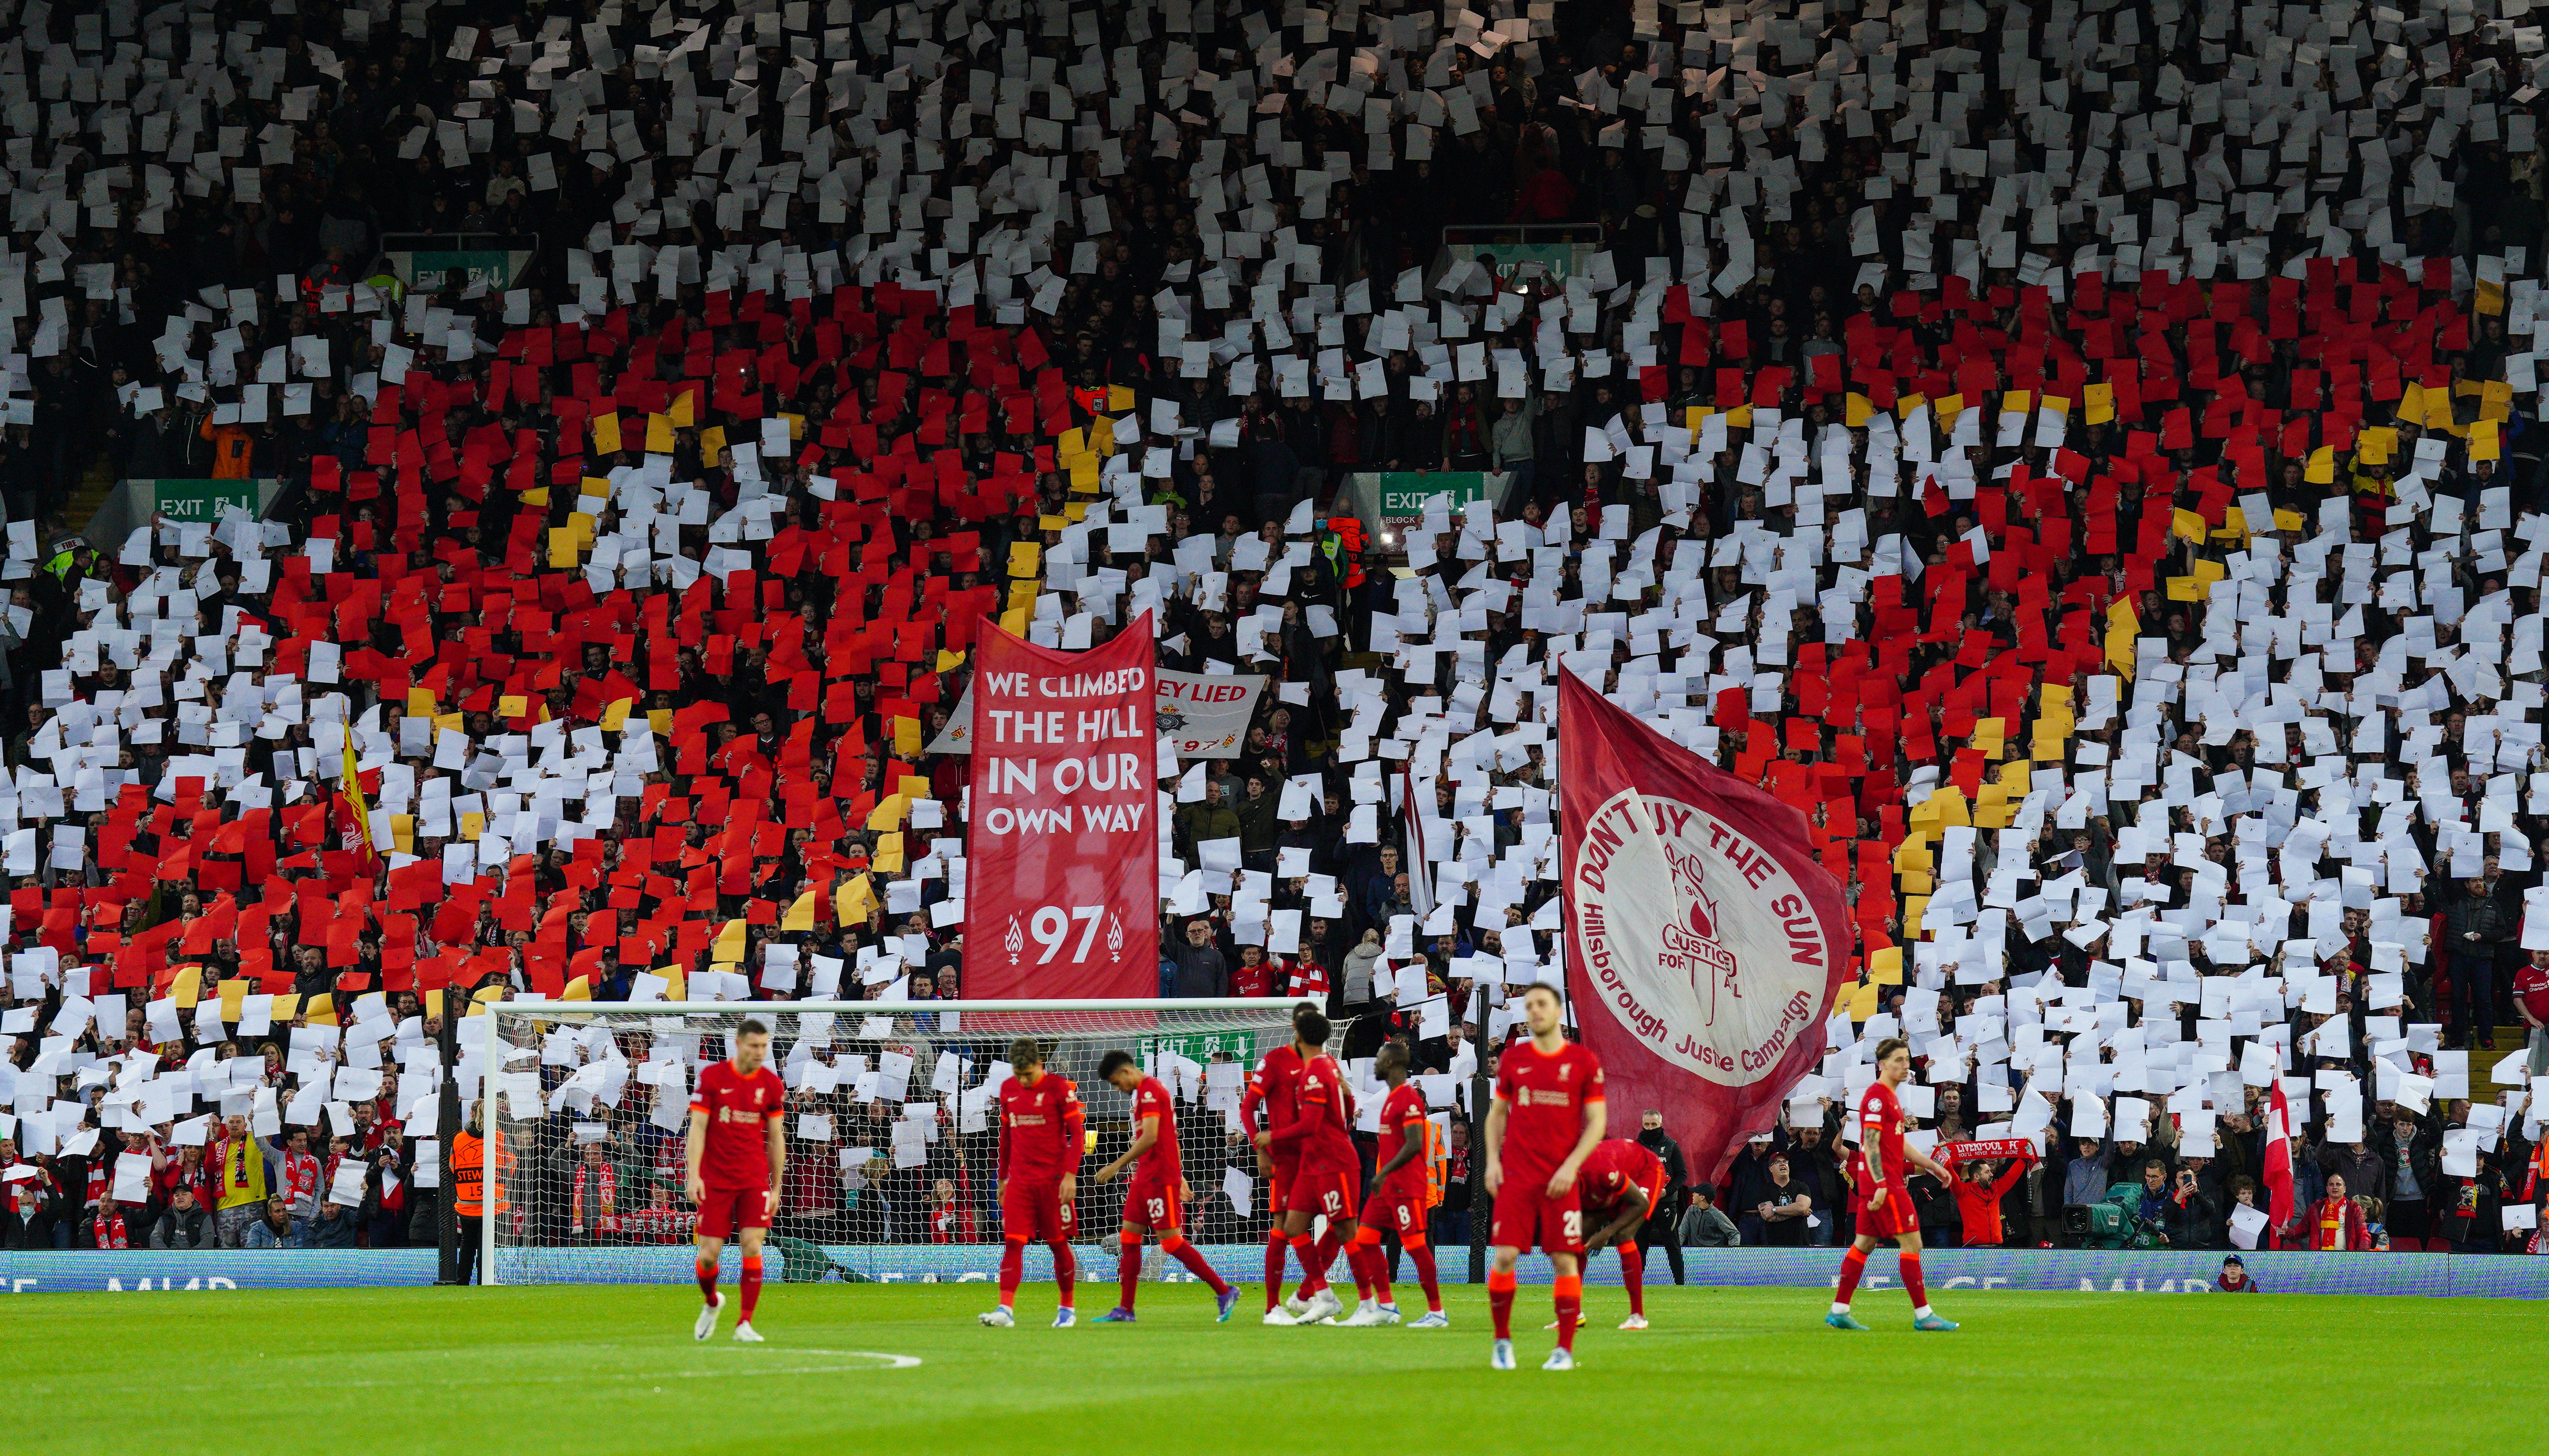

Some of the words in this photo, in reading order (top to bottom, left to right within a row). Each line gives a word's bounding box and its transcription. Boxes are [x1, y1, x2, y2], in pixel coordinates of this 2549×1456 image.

[417, 271, 447, 285] EXI
[161, 500, 204, 516] EXIT
[1386, 493, 1429, 509] EXIT
[61, 540, 77, 550] FIRE
[986, 671, 1029, 697] WE
[1039, 667, 1145, 697] CLIMBED
[1190, 683, 1247, 703] LIED
[988, 710, 1064, 743] THE
[1077, 705, 1143, 743] HILL
[988, 758, 1037, 794] IN
[1053, 753, 1141, 794] OUR
[986, 805, 1072, 835] OWN
[1081, 803, 1146, 832] WAY
[1580, 798, 1639, 894] DON'T
[1642, 802, 1693, 837] UY
[1709, 821, 1777, 890] THE
[1771, 893, 1823, 967] SUN
[1030, 906, 1105, 965] 97
[1659, 952, 1687, 970] FOR
[1583, 903, 1668, 1044] Hillsborough
[1741, 990, 1812, 1071] Campaign
[1141, 1038, 1188, 1056] EXIT
[1955, 1141, 2003, 1153] LIVERPOOL
[2009, 1141, 2019, 1150] FC
[761, 1190, 771, 1213] 7
[1146, 1197, 1165, 1218] 23
[1323, 1190, 1342, 1212] 12
[1060, 1203, 1072, 1223] 9
[1397, 1205, 1411, 1225] 8
